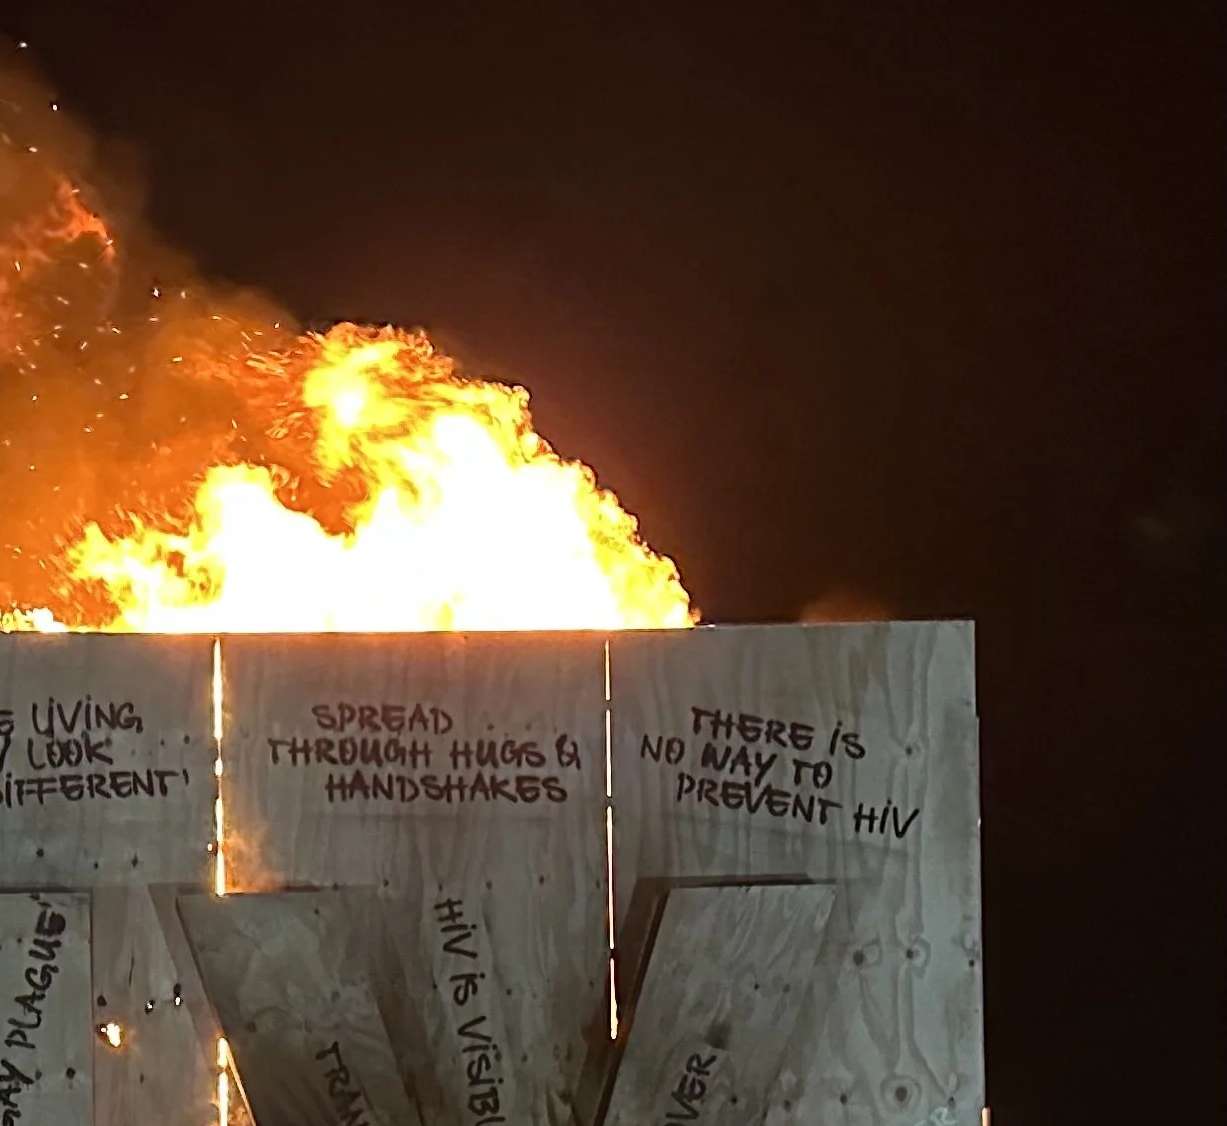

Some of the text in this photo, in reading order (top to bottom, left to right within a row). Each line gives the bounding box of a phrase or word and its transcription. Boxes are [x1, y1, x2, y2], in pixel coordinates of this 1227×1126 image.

[312, 703, 453, 734] SPREAD
[691, 707, 814, 750] THERE
[27, 731, 113, 771] LOOK
[268, 738, 431, 769] THROUGH
[450, 740, 546, 769] HUGS
[641, 734, 832, 788] NO WAY TO
[325, 772, 568, 804] HANDSHAKES
[677, 773, 842, 825] PREVENT
